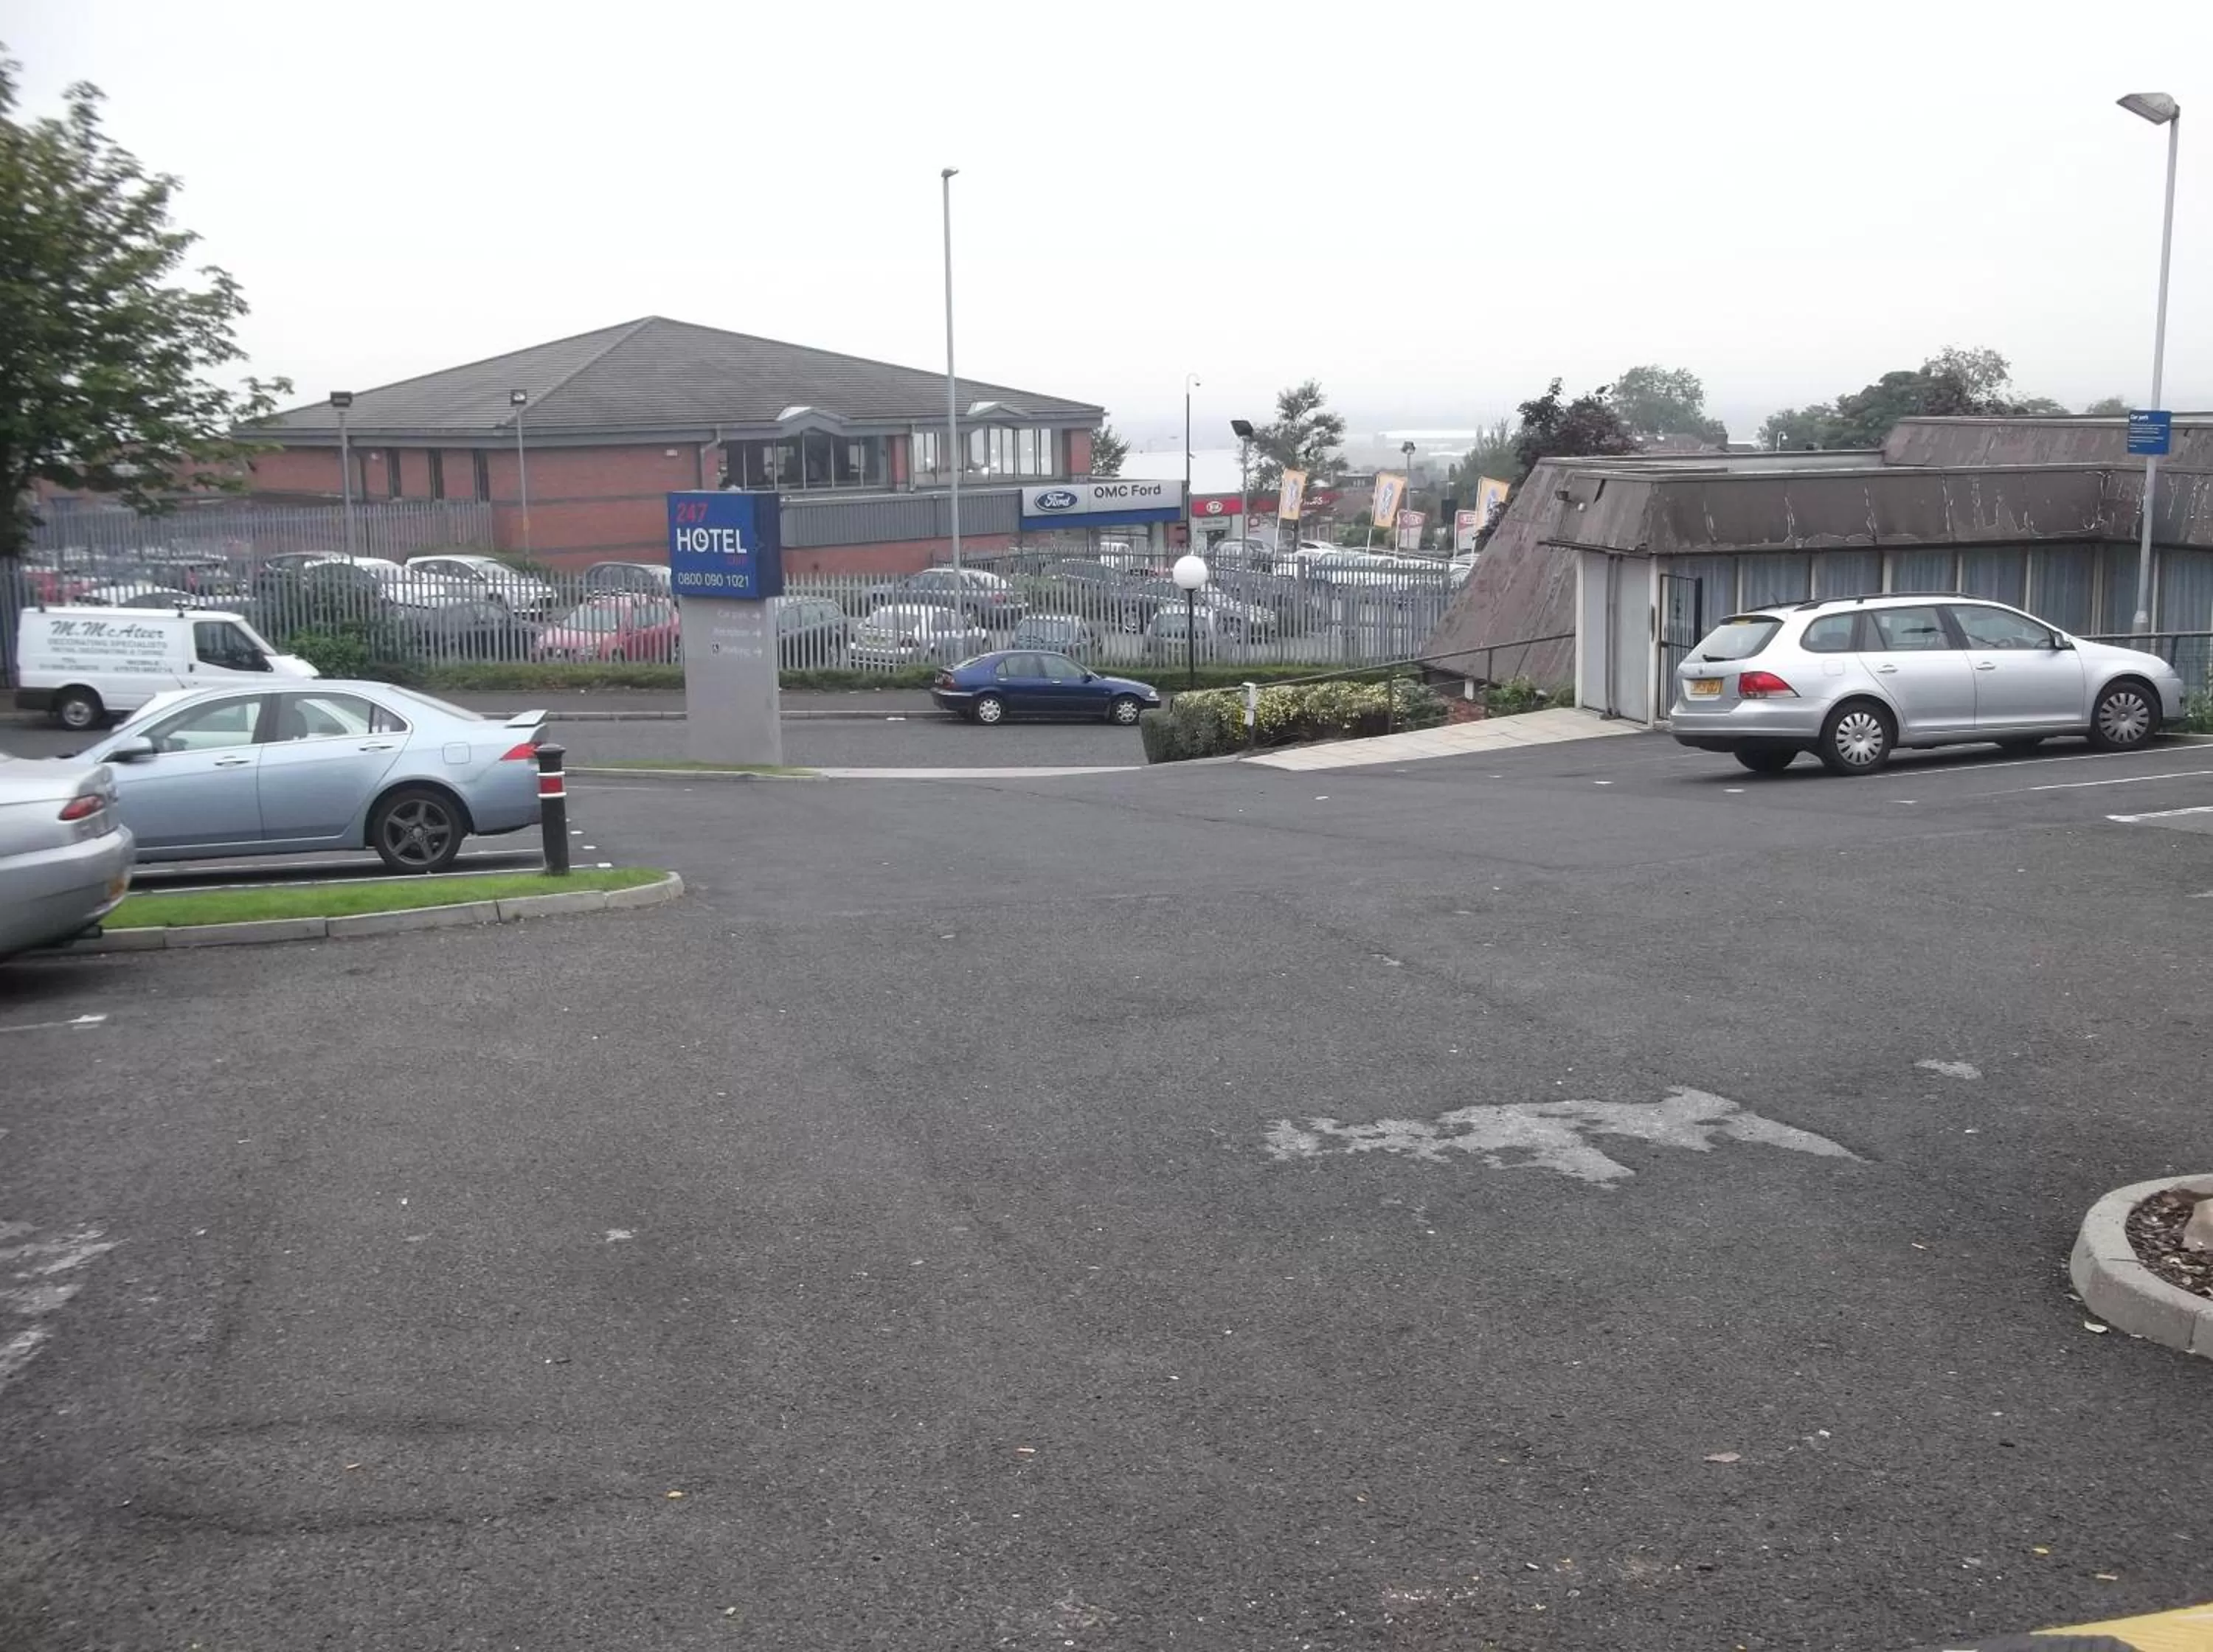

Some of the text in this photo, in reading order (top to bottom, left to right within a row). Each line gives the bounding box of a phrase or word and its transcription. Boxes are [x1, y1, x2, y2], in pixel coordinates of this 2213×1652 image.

[1094, 484, 1161, 498] OMC Ford
[1043, 493, 1071, 507] Ford
[676, 528, 747, 554] HOTEL
[678, 572, 749, 588] 0800 090 1021
